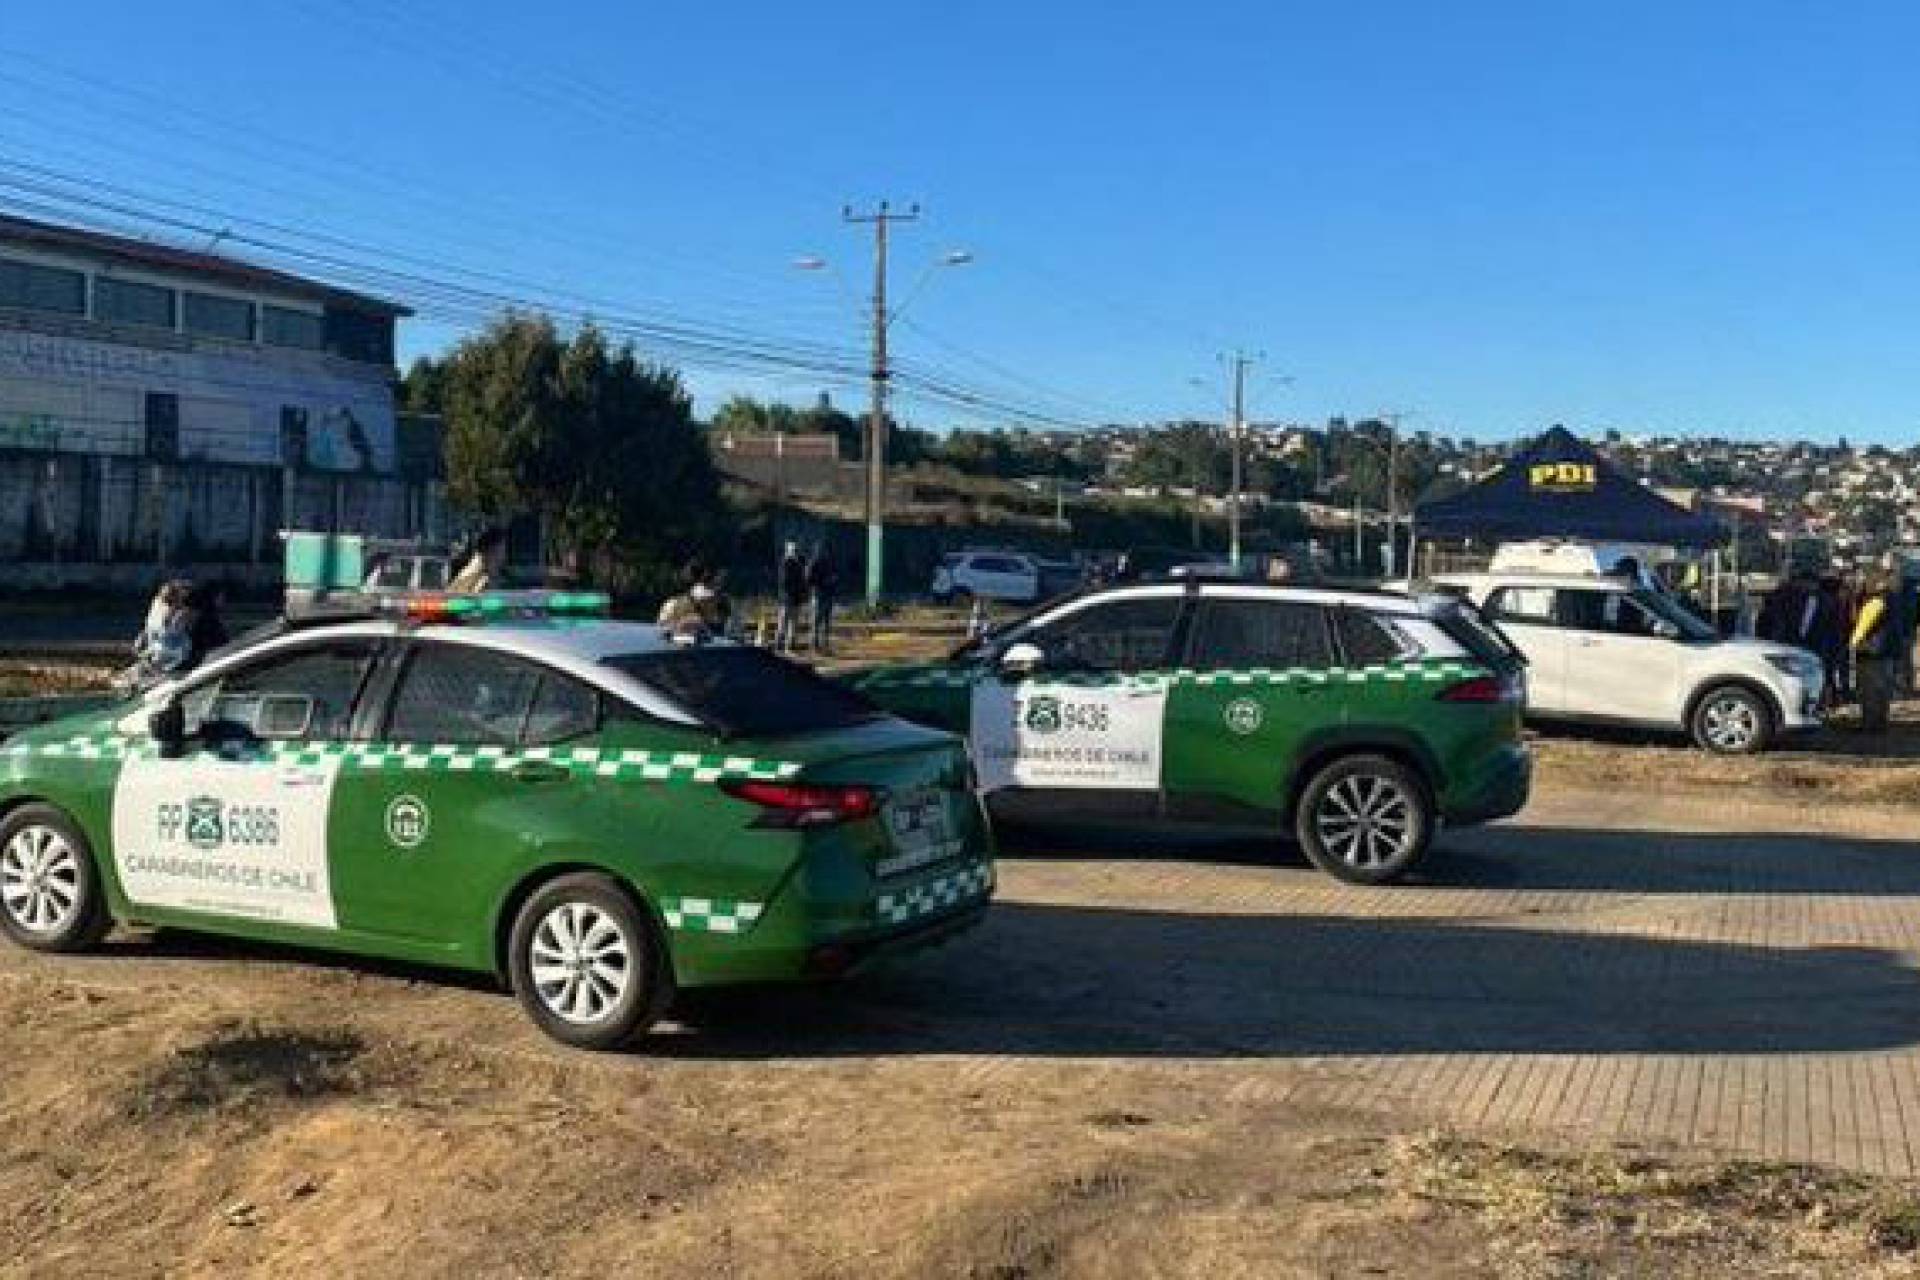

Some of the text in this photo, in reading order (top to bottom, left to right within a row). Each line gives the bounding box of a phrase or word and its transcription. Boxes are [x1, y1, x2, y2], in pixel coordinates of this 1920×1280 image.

[1530, 463, 1597, 485] PDI
[1087, 748, 1105, 764] DE
[1108, 749, 1149, 765] CHILE
[125, 855, 317, 892] CARABINEROS DE CHILE
